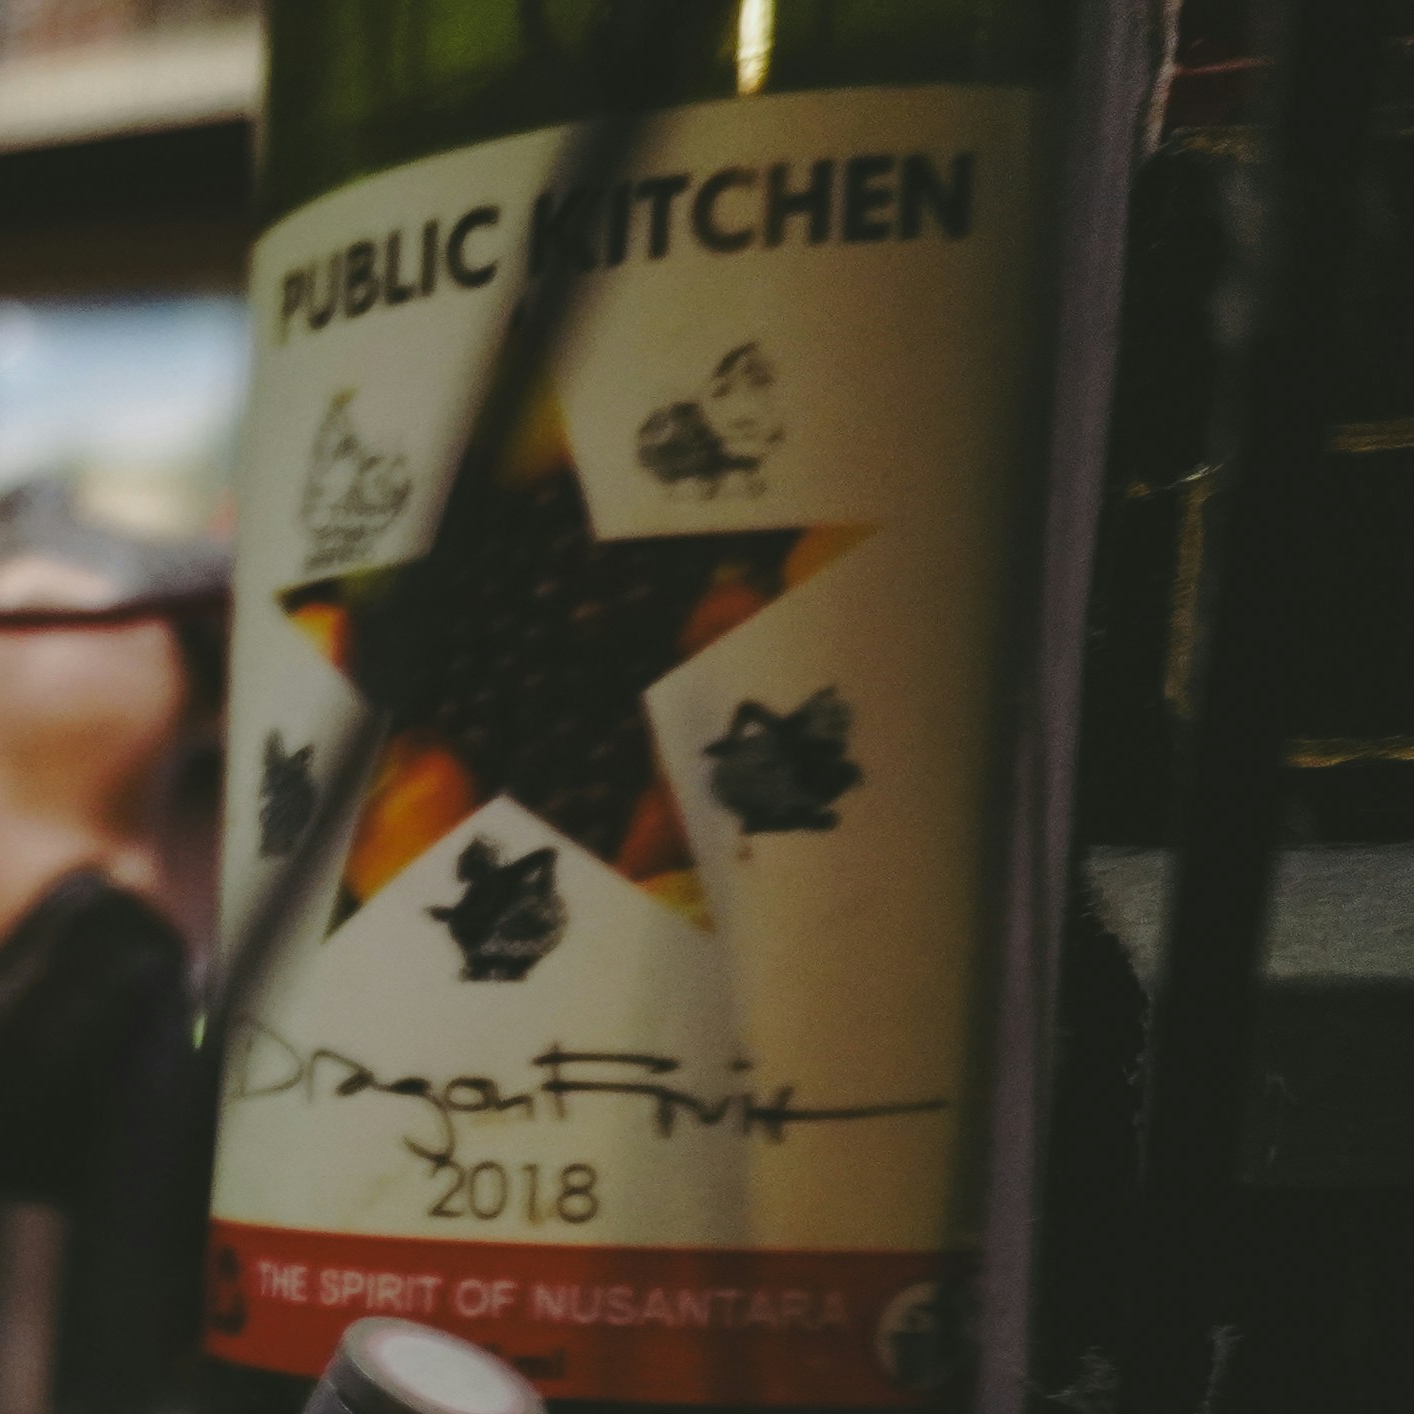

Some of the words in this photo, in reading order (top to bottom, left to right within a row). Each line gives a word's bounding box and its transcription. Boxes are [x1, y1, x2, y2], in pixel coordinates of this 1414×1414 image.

[278, 204, 502, 344] PUBLIC
[528, 150, 976, 278] KITCHEN
[222, 1015, 538, 1166] Dragon
[428, 1160, 599, 1224] 2018
[258, 1257, 309, 1302] THE
[318, 1267, 444, 1313] SPIRIT
[454, 1277, 519, 1320] OF
[530, 1281, 854, 1332] NUSANTARA
